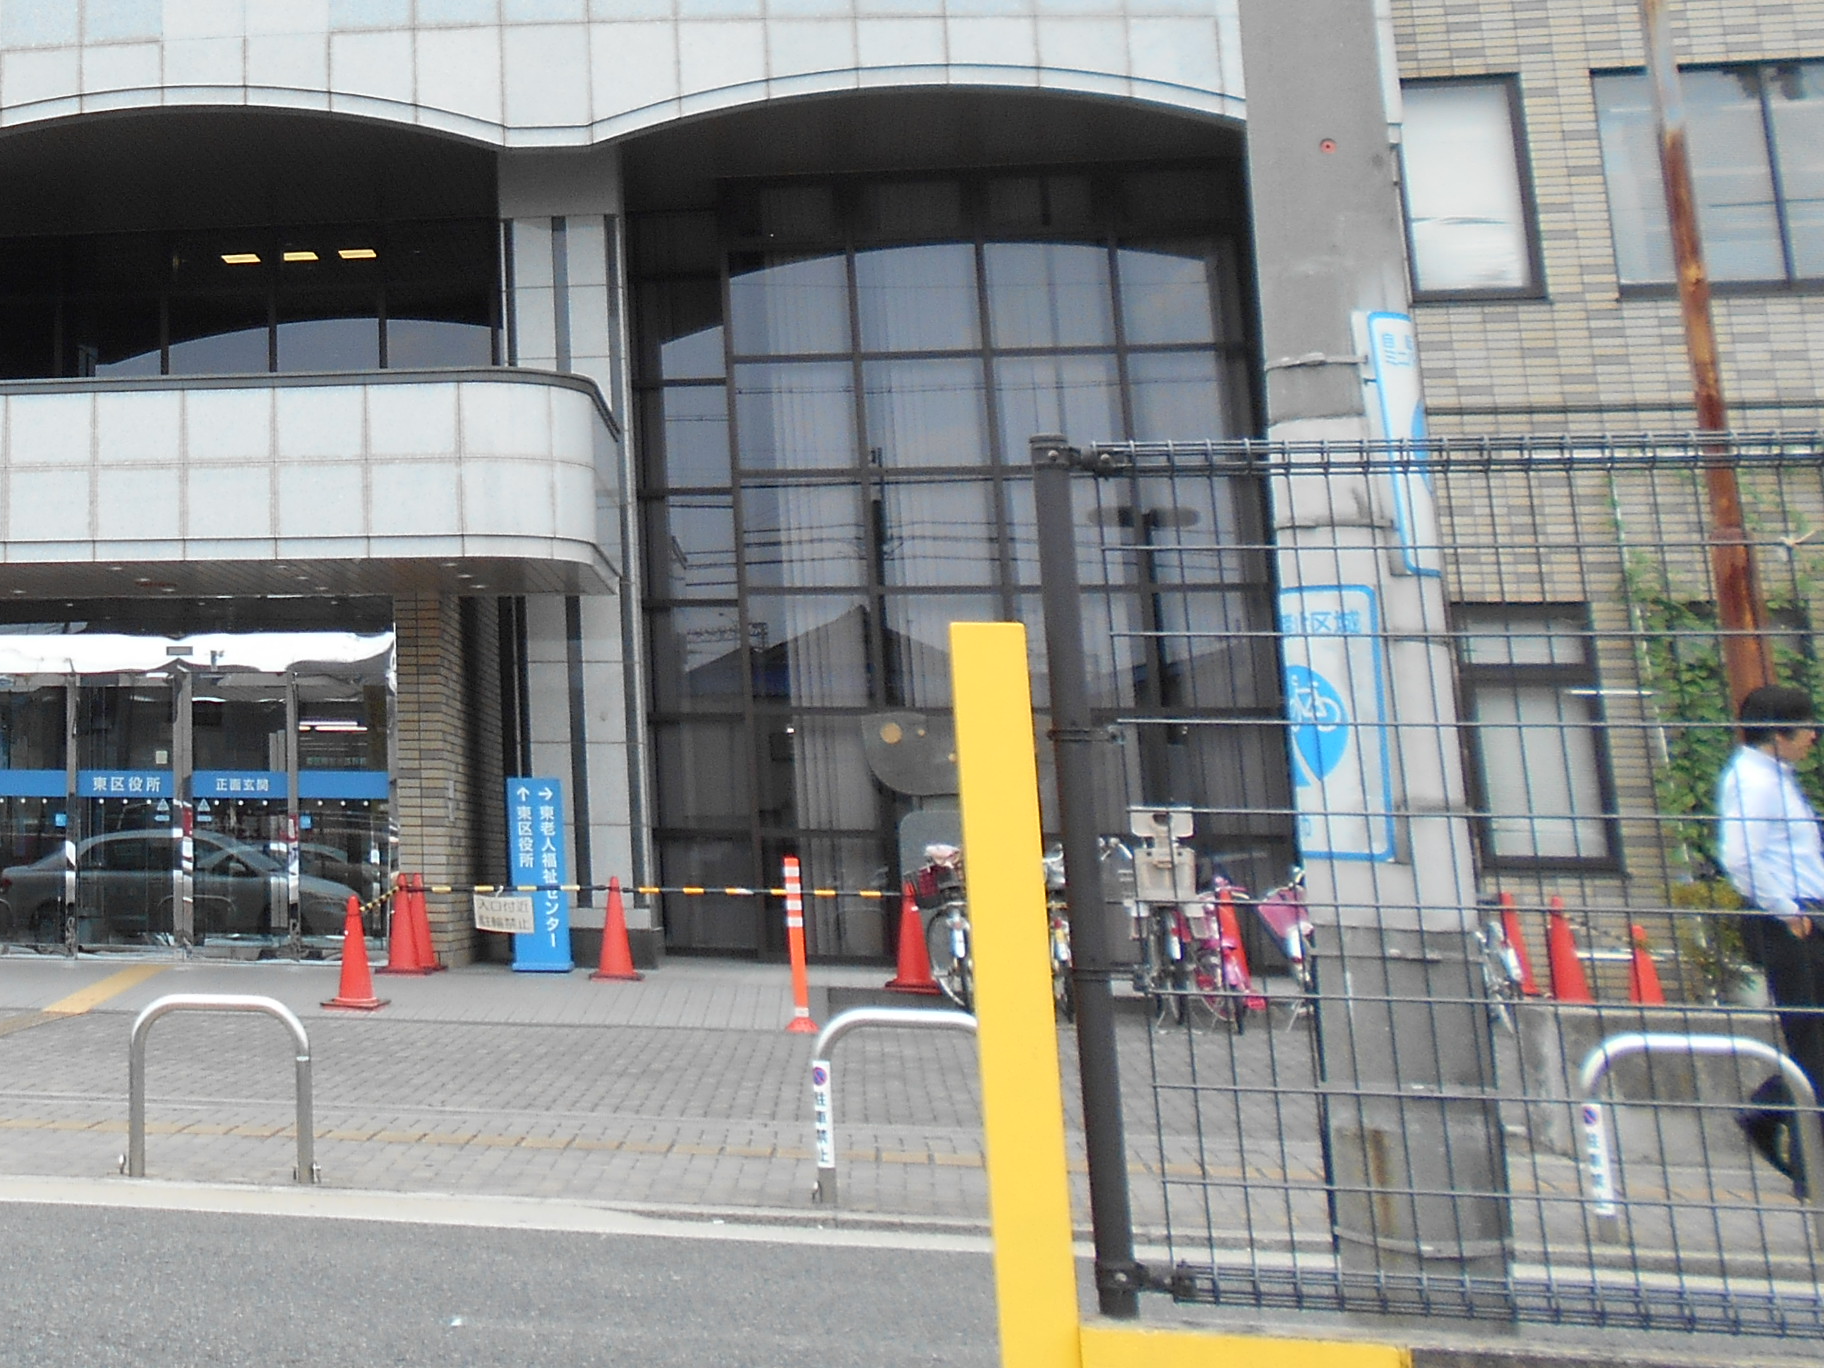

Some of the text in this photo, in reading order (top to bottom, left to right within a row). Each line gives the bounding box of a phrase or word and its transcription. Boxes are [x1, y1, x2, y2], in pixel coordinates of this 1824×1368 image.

[92, 776, 161, 793] 東区役所
[215, 777, 269, 792] 正面玄関
[516, 806, 534, 868] 東区役所
[539, 805, 560, 948] 東老人福祉センター
